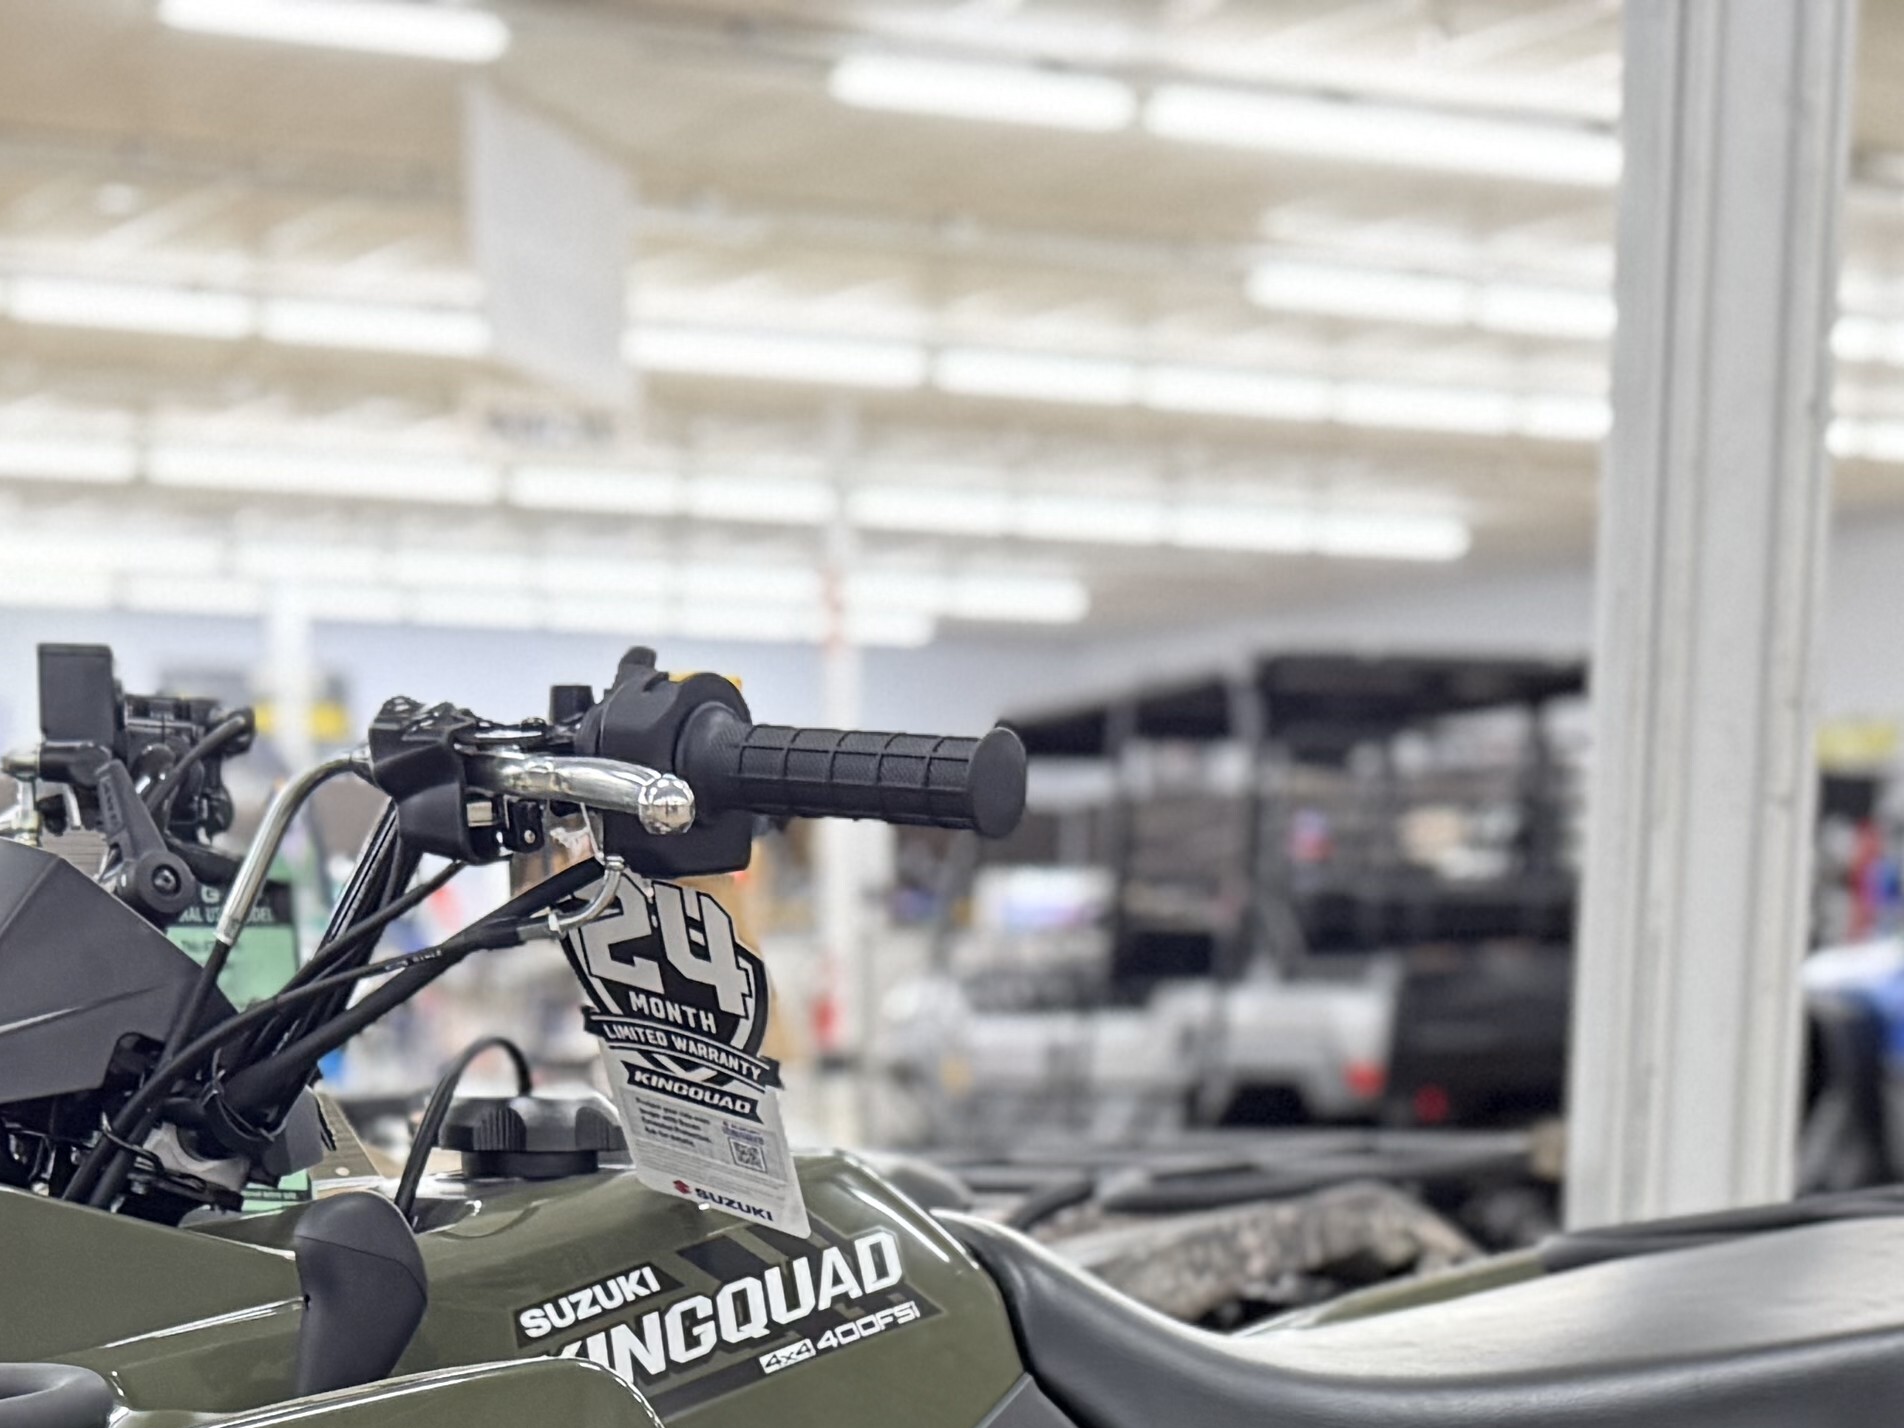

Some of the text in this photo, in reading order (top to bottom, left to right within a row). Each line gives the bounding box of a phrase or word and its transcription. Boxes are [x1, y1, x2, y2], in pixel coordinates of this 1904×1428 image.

[577, 874, 752, 1016] 24
[629, 990, 717, 1034] MONTH
[603, 1025, 762, 1081] LIMITED WARRANTY
[633, 1069, 752, 1115] KINGQUAD
[695, 1187, 774, 1222] SUZUKI
[519, 1265, 661, 1339] SUZUKI
[559, 1231, 903, 1384] INGQUAD
